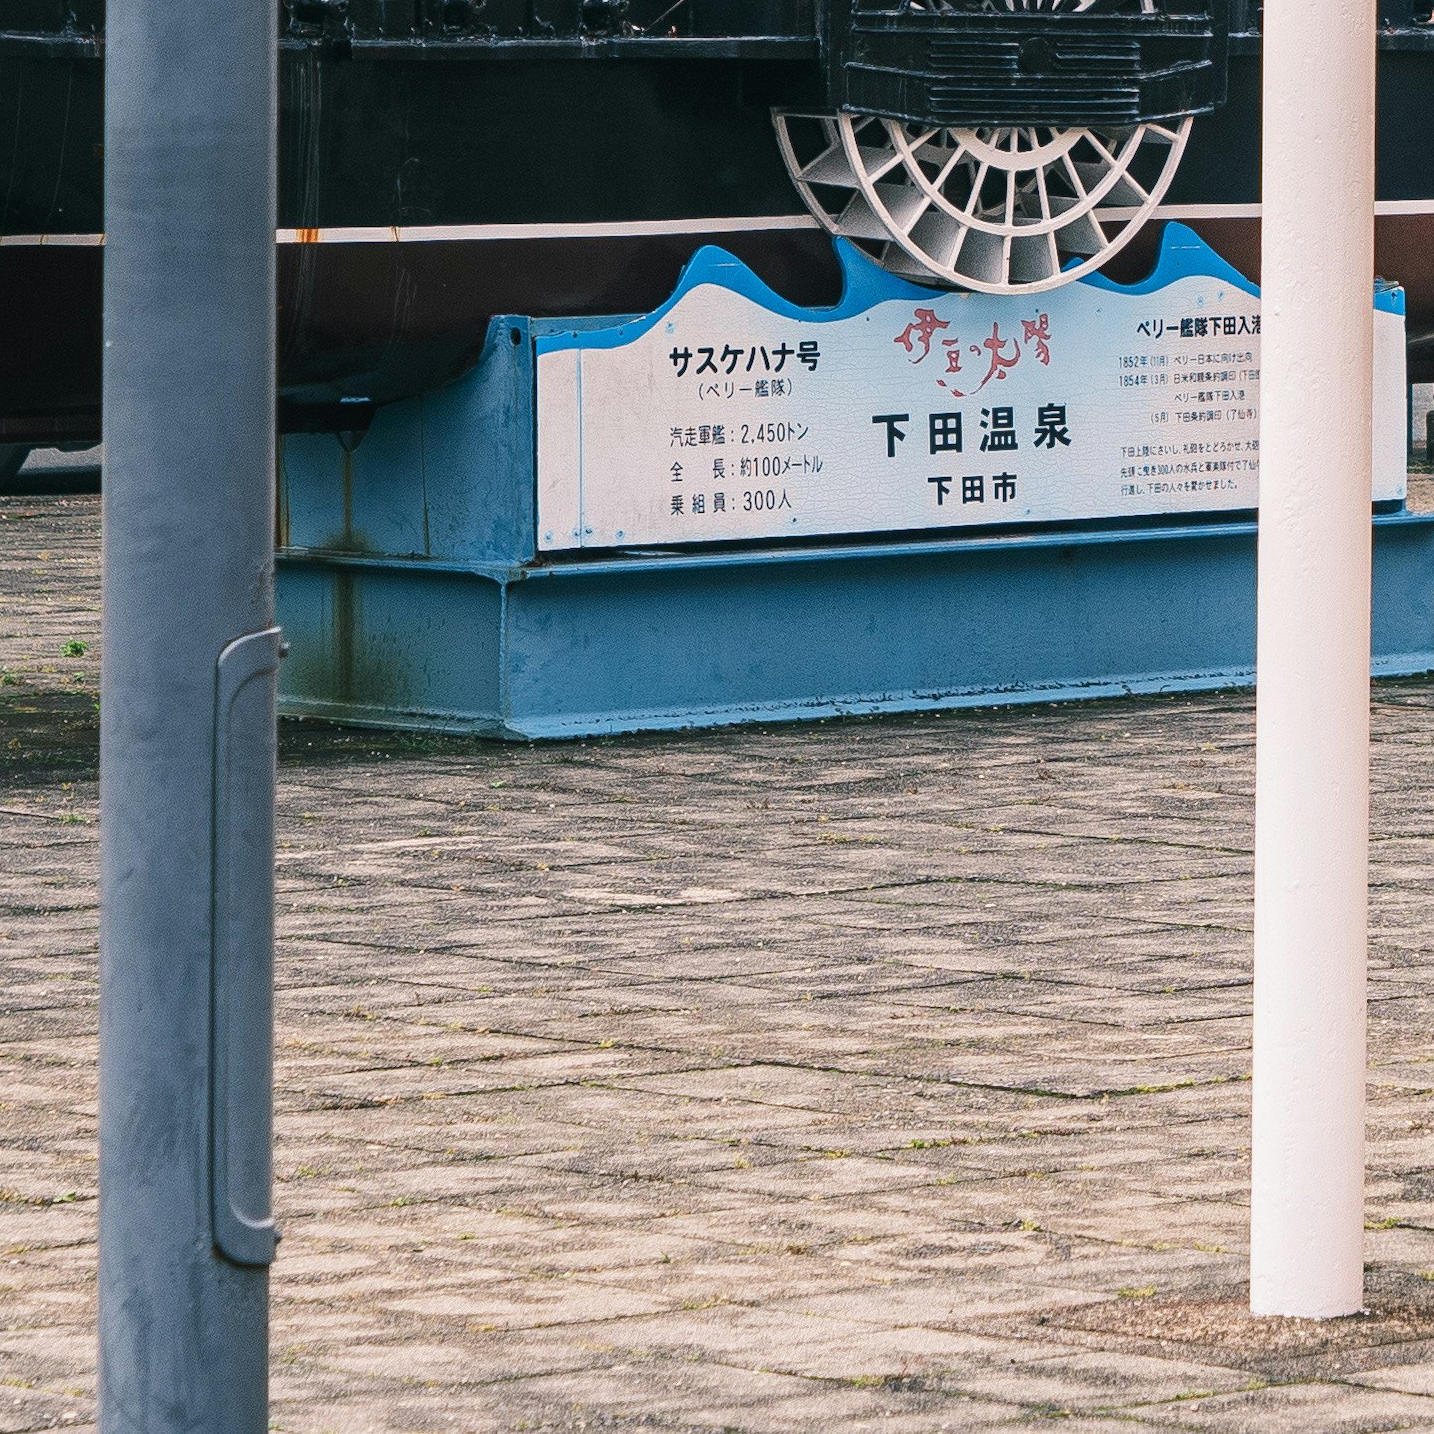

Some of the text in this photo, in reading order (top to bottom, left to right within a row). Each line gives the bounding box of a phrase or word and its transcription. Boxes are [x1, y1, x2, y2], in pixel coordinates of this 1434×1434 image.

[669, 341, 821, 378] サスケハナ号
[698, 378, 793, 400] (ペリー艦隊)
[872, 403, 1072, 457] 下田温泉
[927, 472, 1017, 506] 下田市
